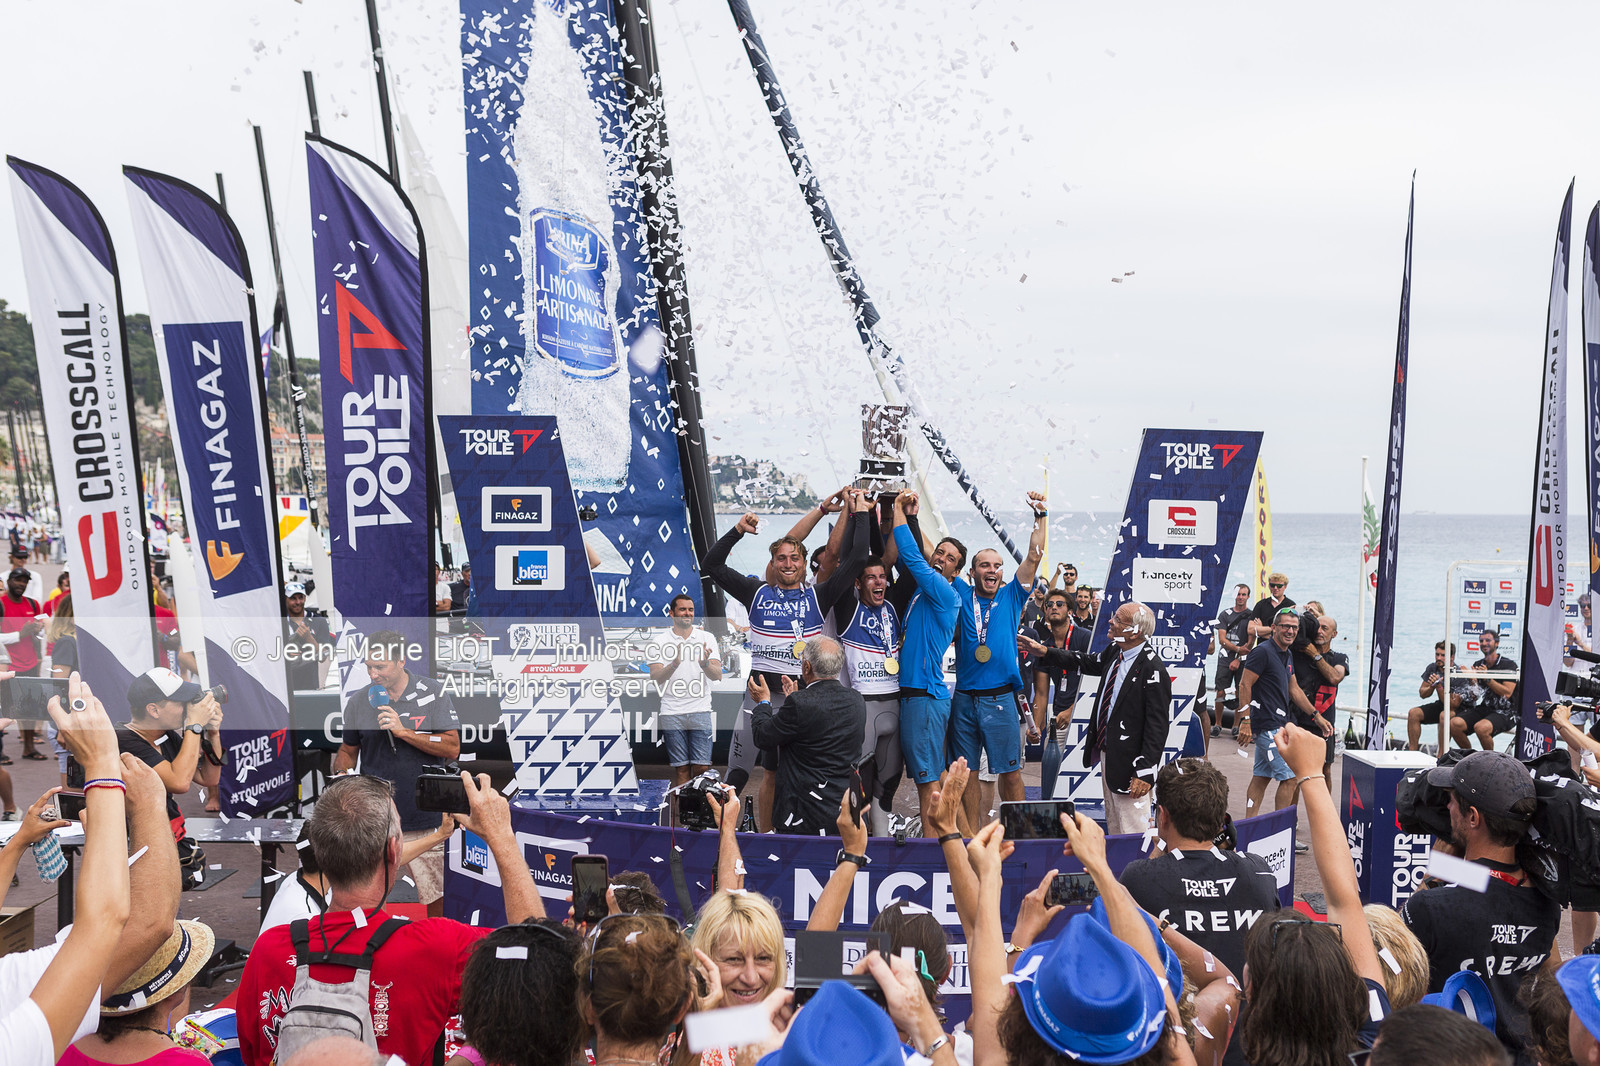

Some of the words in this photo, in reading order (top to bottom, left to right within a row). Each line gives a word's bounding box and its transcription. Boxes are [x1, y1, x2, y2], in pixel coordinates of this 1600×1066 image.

[97, 301, 117, 423] TECHNOLOGY
[56, 302, 115, 502] CROSSCALL
[191, 339, 242, 532] FINAGAZ
[458, 429, 511, 443] TOUR
[374, 374, 413, 525] VOILE
[465, 442, 515, 456] VOILE
[1159, 442, 1211, 457] TOUR
[110, 432, 128, 497] MOBILE
[341, 390, 379, 552] TOUR
[1165, 456, 1215, 470] VOILE
[495, 512, 538, 520] FINAGAZ
[1167, 528, 1196, 536] CROSSCALL
[124, 505, 139, 590] OUTDOOR
[518, 567, 548, 580] bleu
[1555, 524, 1566, 610] OUTDOOR
[597, 578, 627, 613] INA
[1164, 581, 1192, 591] sport
[533, 625, 561, 634] VILLE
[563, 625, 577, 634] DE
[541, 634, 577, 648] NICE
[1155, 646, 1182, 660] ICE
[229, 735, 270, 757] TOUR
[1524, 726, 1545, 749] TOUR
[235, 748, 273, 772] VOILE
[230, 771, 291, 804] #TOURVOILE
[465, 847, 488, 869] bleu
[473, 844, 488, 854] france
[1392, 833, 1413, 908] TOUR
[1181, 877, 1216, 891] TOUR
[1184, 886, 1220, 898] VOILE
[793, 867, 962, 925] NICE
[1158, 908, 1264, 932] CREW
[1491, 924, 1517, 937] TOUR
[1490, 934, 1518, 945] VOILE
